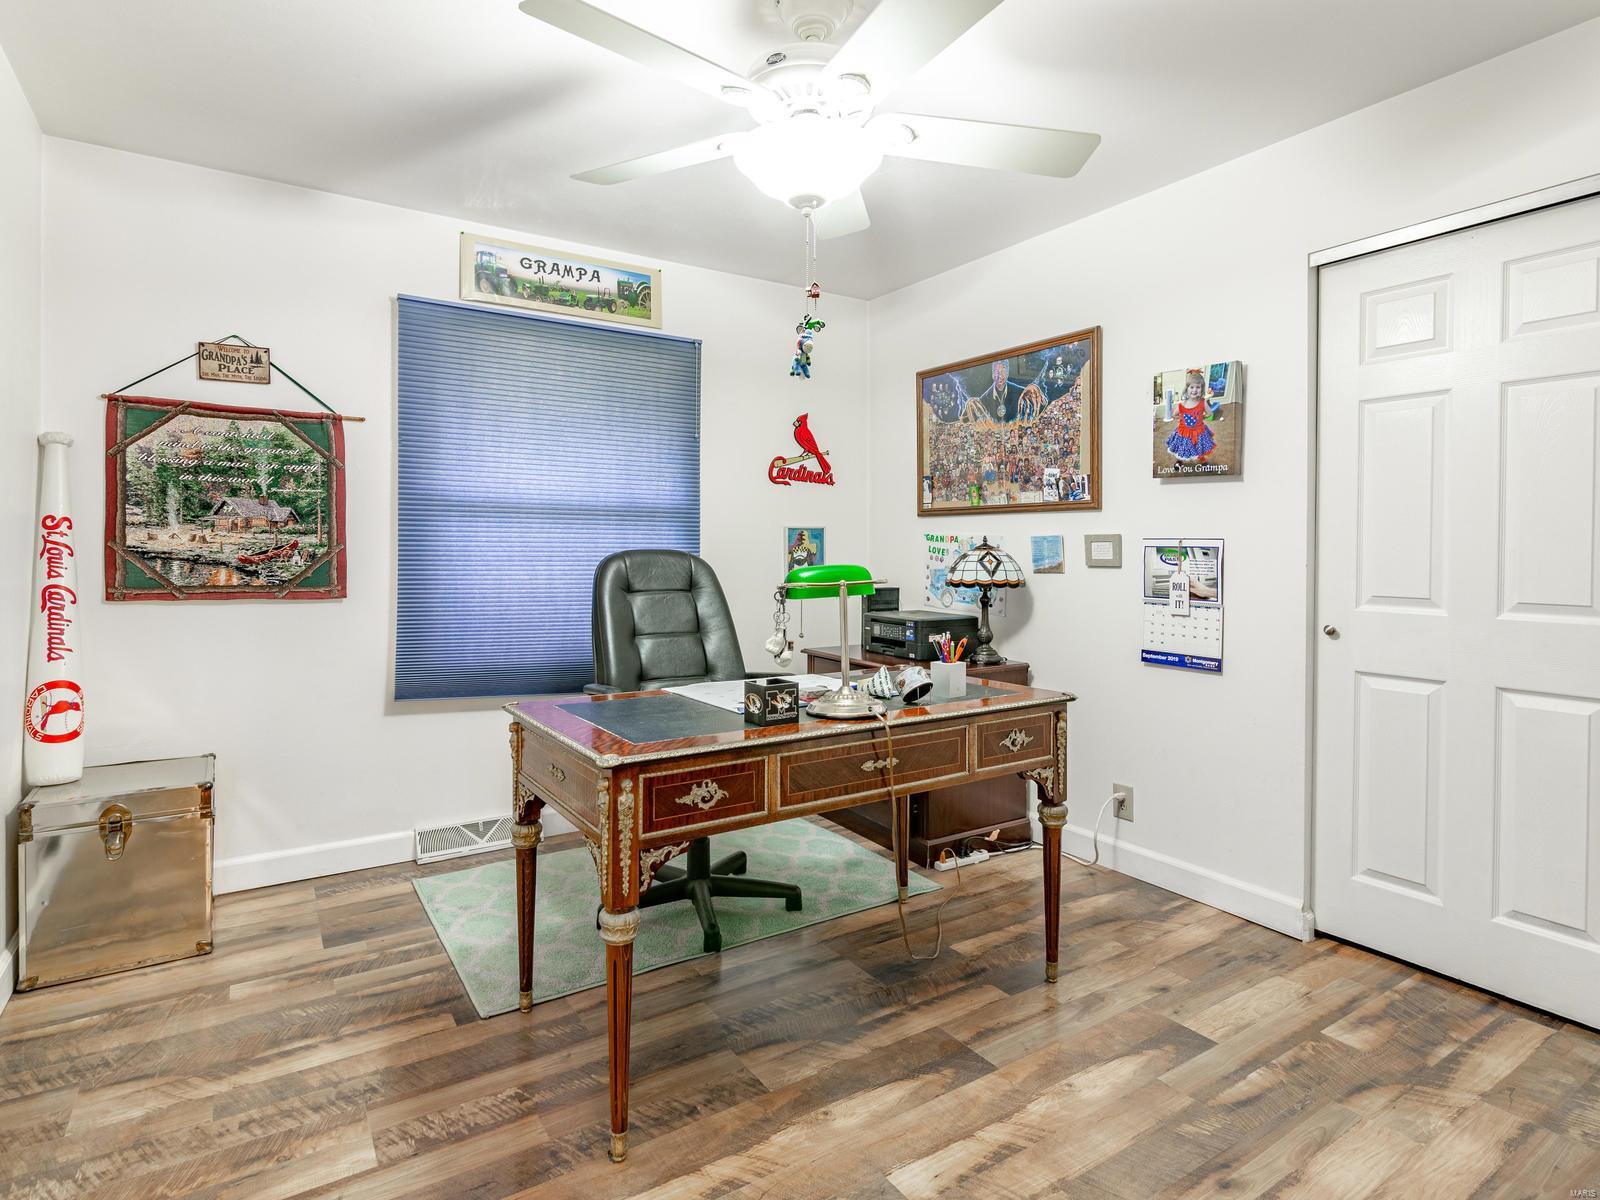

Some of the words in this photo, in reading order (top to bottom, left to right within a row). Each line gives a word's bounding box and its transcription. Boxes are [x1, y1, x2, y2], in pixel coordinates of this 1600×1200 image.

[519, 257, 601, 283] GRAMPA
[201, 348, 248, 366] GRANDPA'S
[217, 363, 255, 375] PLACE
[159, 441, 200, 449] mind
[217, 443, 239, 452] the
[242, 447, 301, 455] greatest
[138, 452, 200, 468] blessing
[254, 462, 281, 470] can
[283, 463, 319, 473] enjoy
[768, 455, 835, 487] Cardinals
[1157, 465, 1175, 474] Love
[1177, 464, 1193, 473] You
[1194, 463, 1229, 475] Grampa
[179, 473, 196, 481] in
[198, 473, 226, 482] this
[227, 476, 275, 485] world
[41, 584, 77, 663] Cardinals
[1142, 652, 1167, 661] September
[25, 685, 47, 741] CARDINALS
